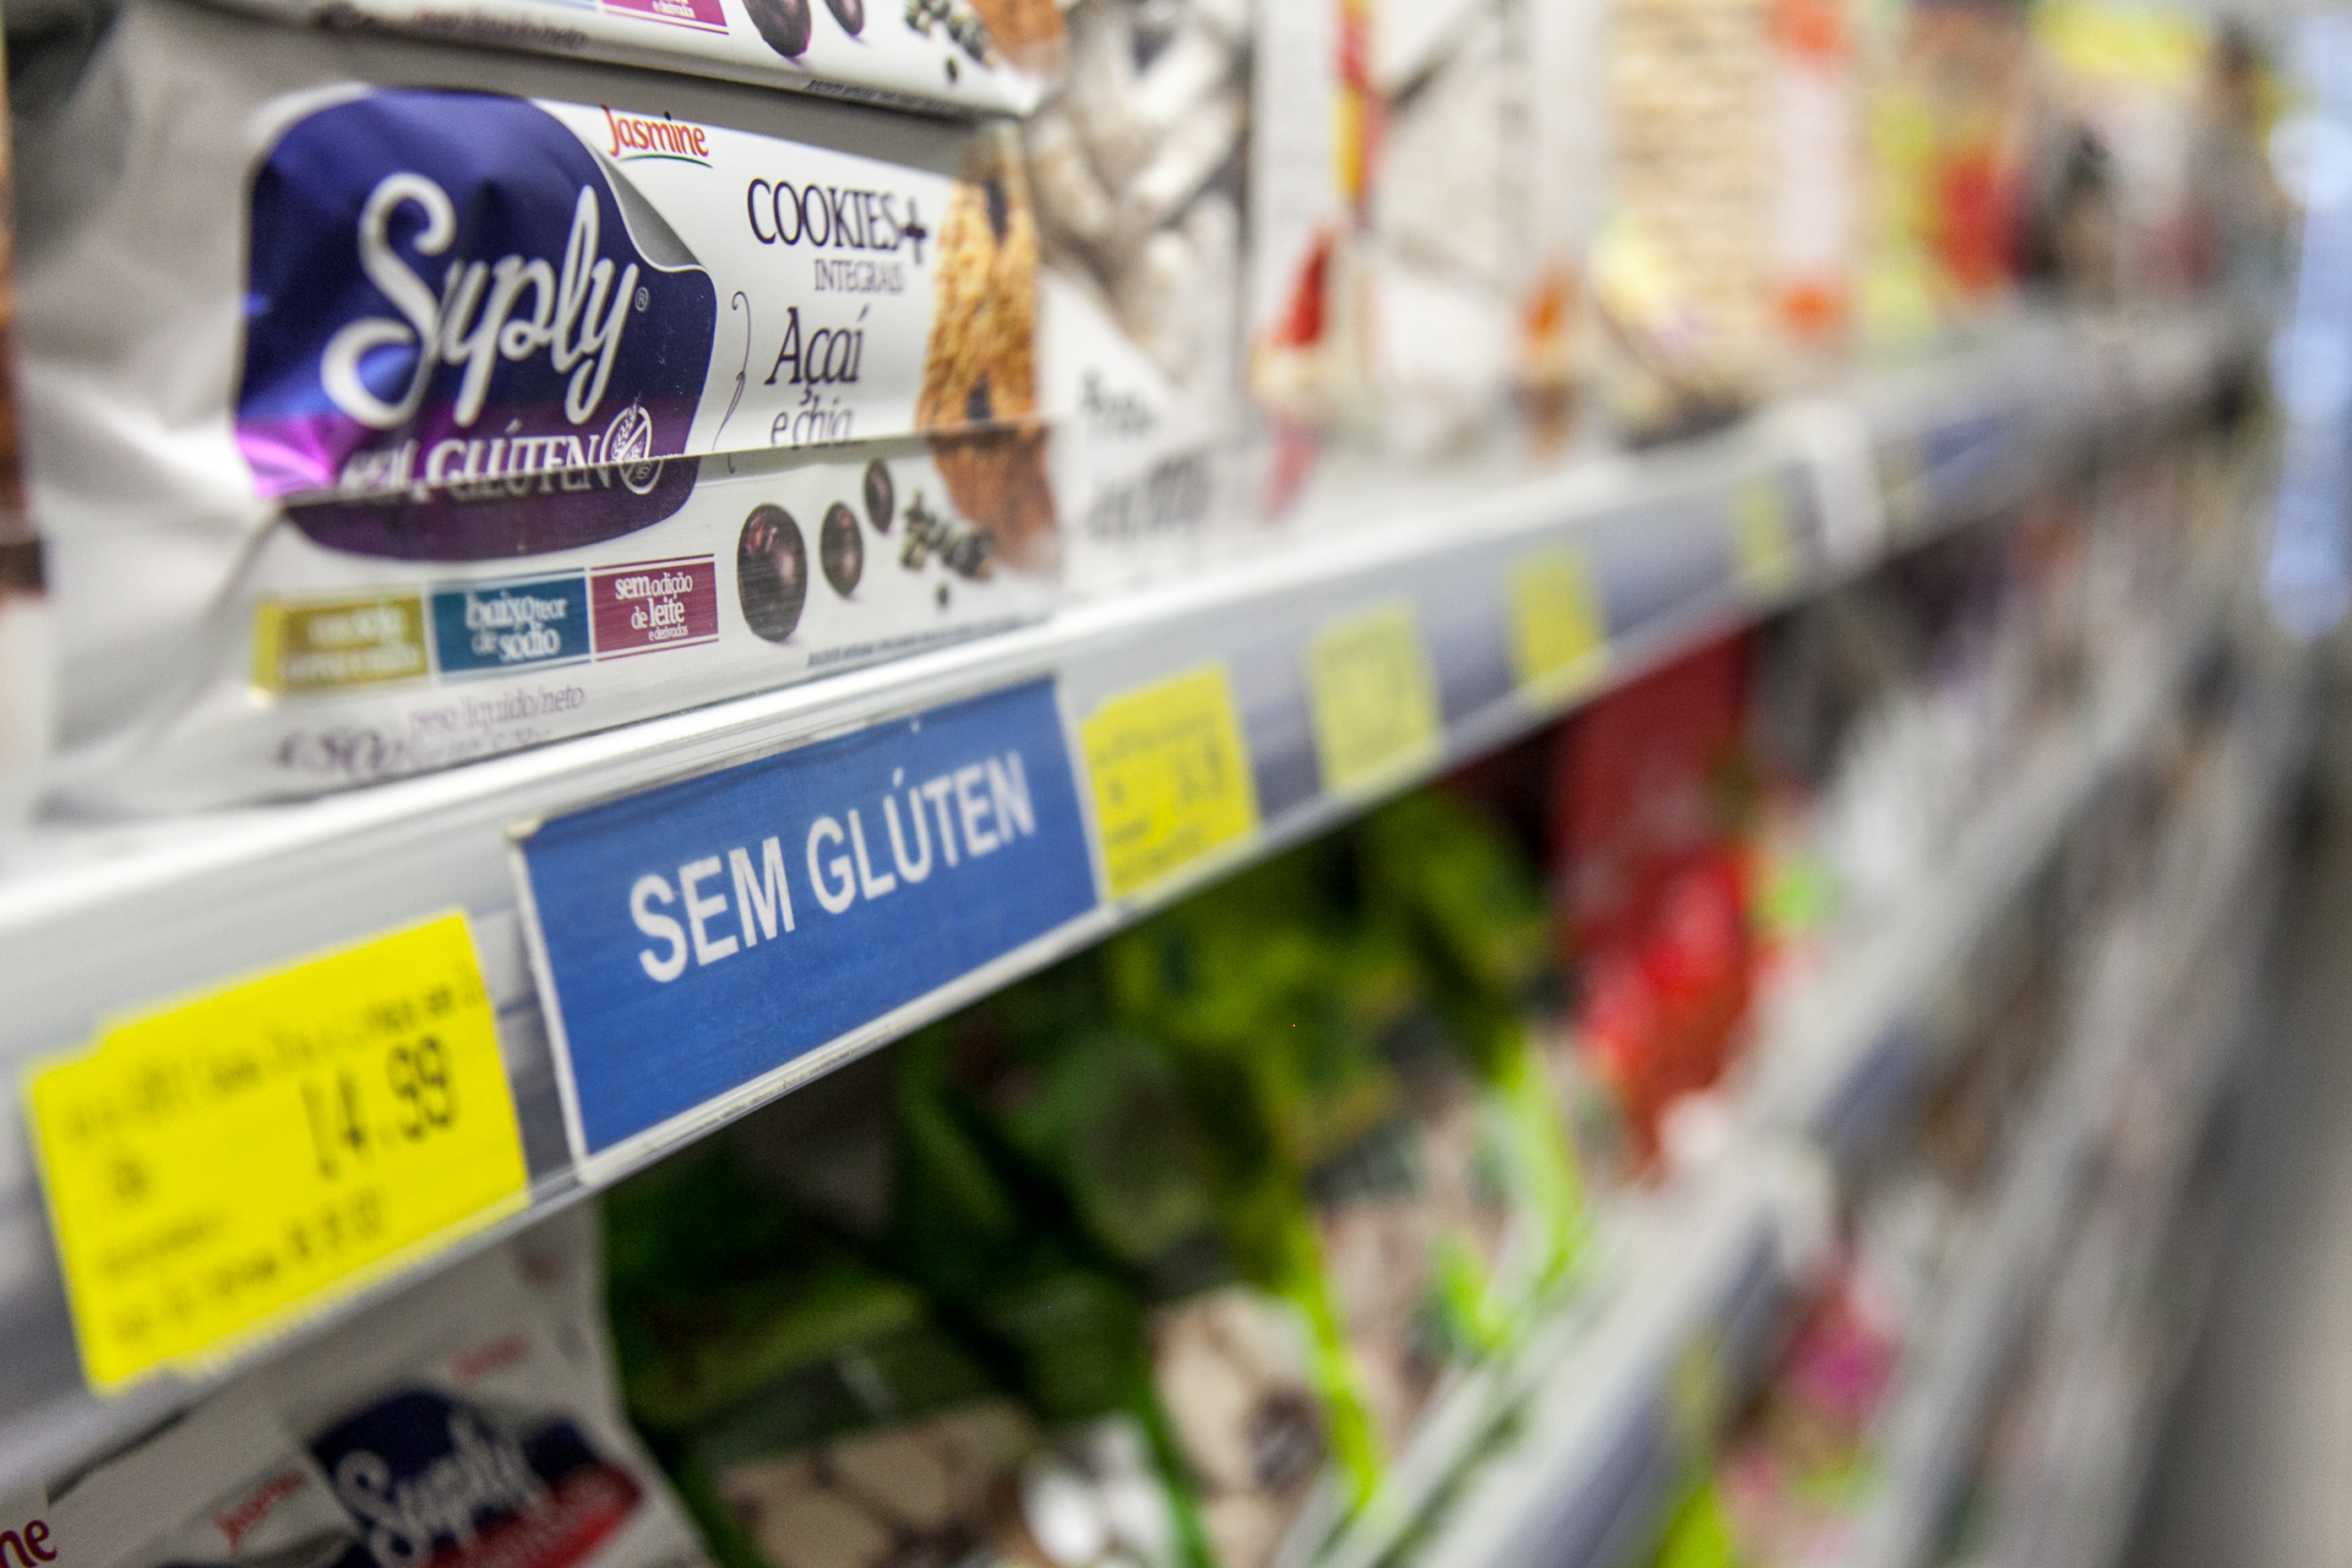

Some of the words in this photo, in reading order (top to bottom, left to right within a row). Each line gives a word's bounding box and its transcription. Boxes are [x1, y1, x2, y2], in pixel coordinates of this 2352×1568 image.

[601, 105, 709, 157] Jasmine
[764, 302, 870, 406] Açaí
[615, 574, 651, 600] sem
[651, 571, 693, 599] adição
[466, 589, 535, 632] baixo
[631, 605, 648, 629] de
[647, 596, 685, 627] leite
[629, 836, 796, 983] SEM
[806, 750, 1037, 914] GLÚTEN
